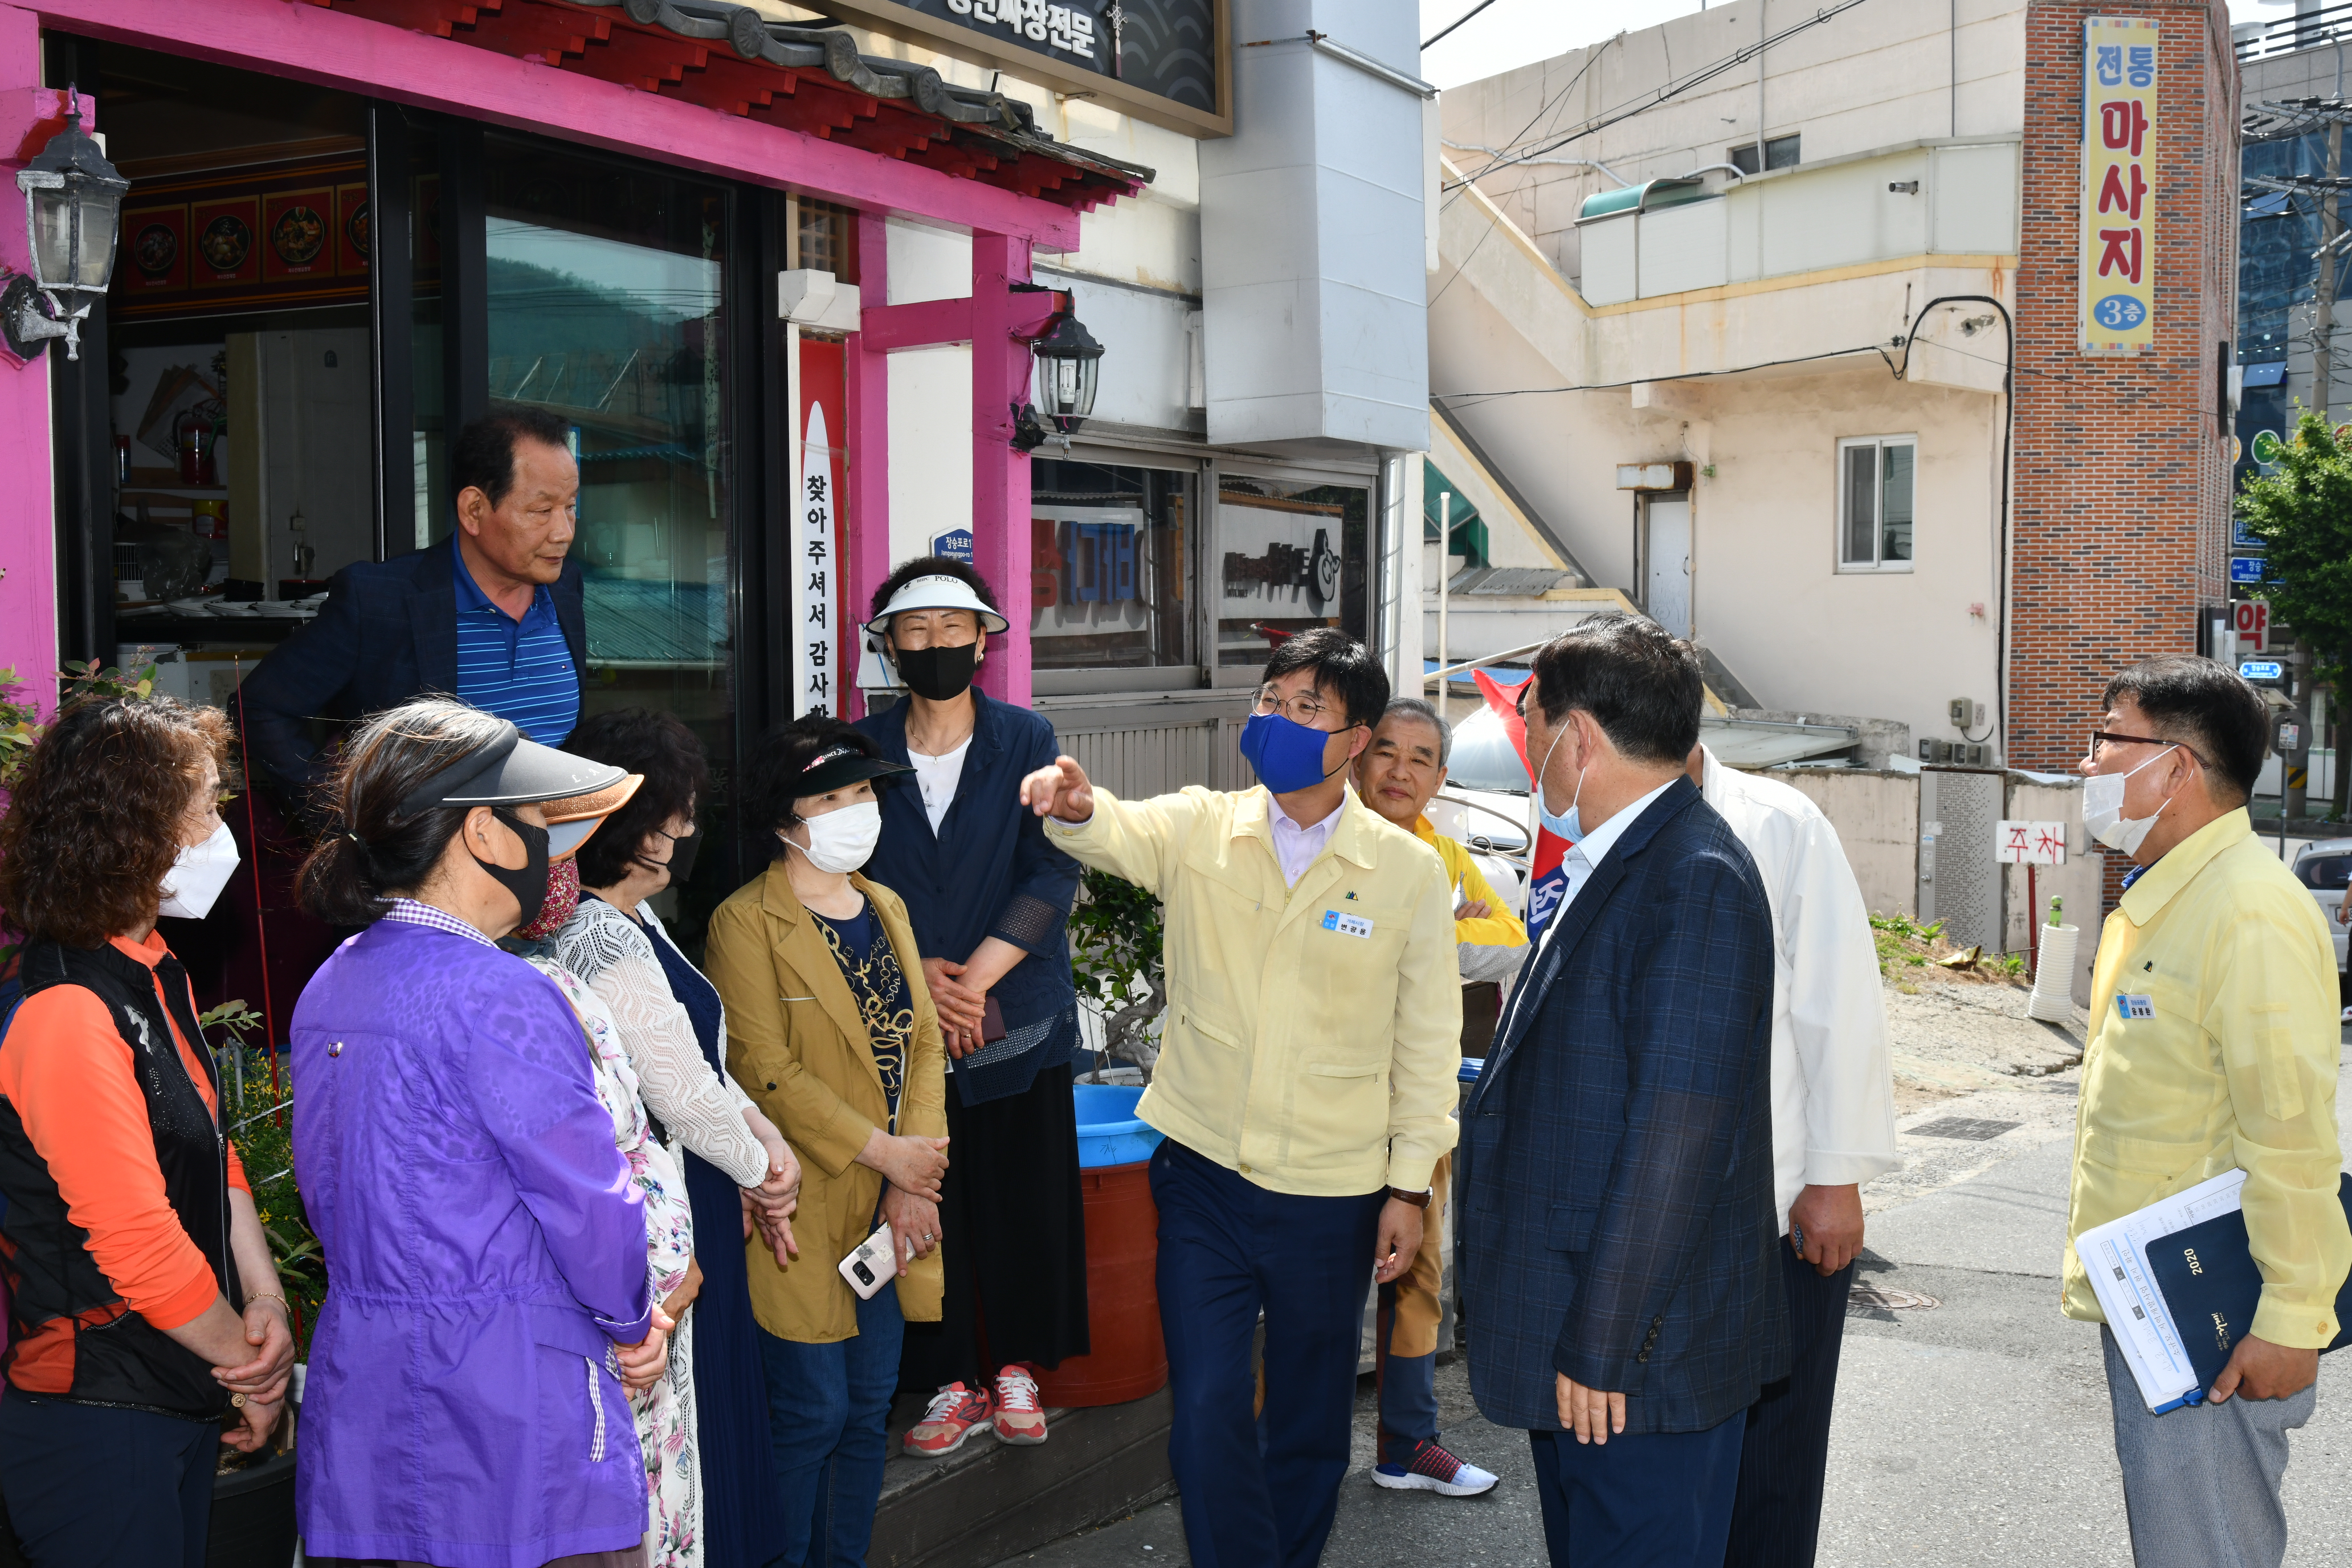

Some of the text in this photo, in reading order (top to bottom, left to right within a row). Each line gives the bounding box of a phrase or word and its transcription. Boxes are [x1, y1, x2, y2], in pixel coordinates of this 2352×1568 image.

[2096, 46, 2154, 87] 전통
[2098, 100, 2149, 284] 마사지
[2104, 300, 2141, 324] 3층
[946, 536, 973, 549] 장승포로1
[934, 575, 958, 584] POLO
[2237, 605, 2267, 650] 약
[823, 750, 837, 760] SINCE
[2008, 827, 2065, 864] 주차
[2121, 1248, 2132, 1263] 확인
[2184, 1248, 2202, 1275] 2020
[2130, 1267, 2142, 1281] 현지
[2139, 1286, 2166, 1330] 지역개발사업
[2165, 1333, 2180, 1355] 소규모
